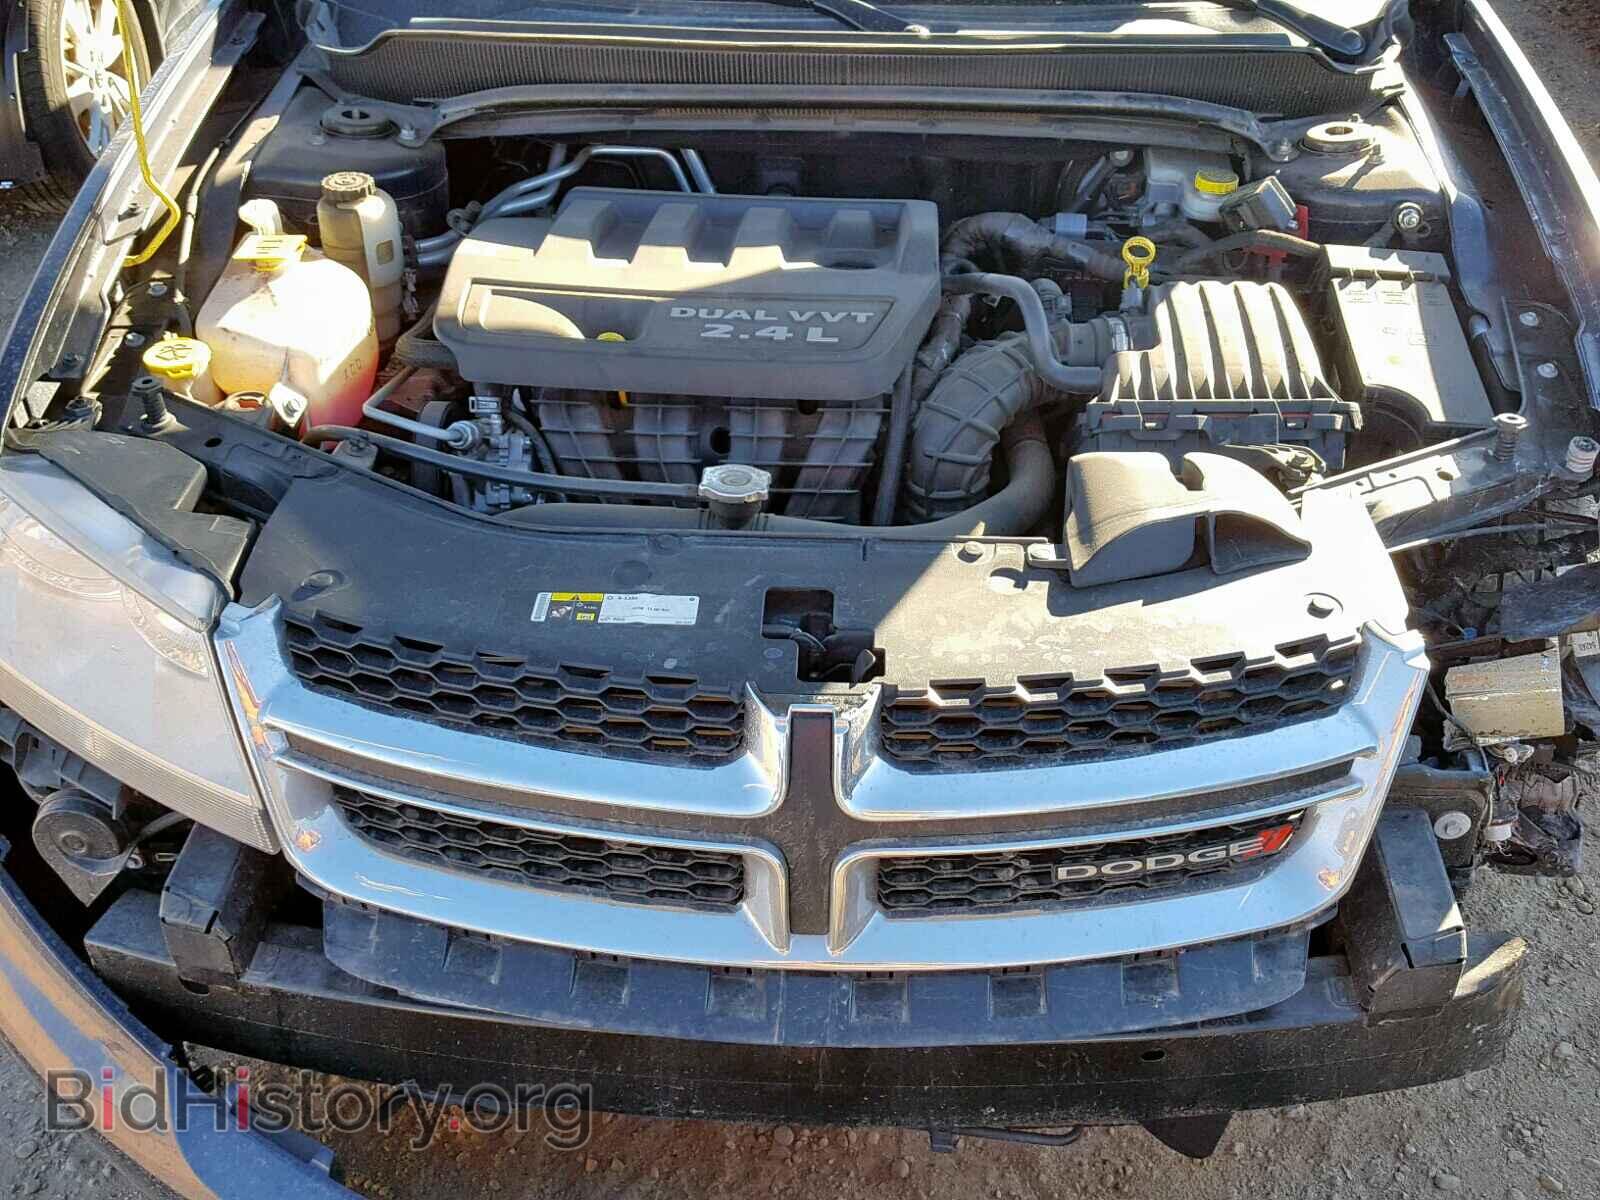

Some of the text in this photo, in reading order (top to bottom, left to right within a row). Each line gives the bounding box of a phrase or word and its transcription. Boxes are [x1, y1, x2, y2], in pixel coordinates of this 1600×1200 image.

[670, 307, 874, 323] DUAL VVT
[700, 323, 839, 342] 2.4 L
[1057, 838, 1264, 881] DODGE
